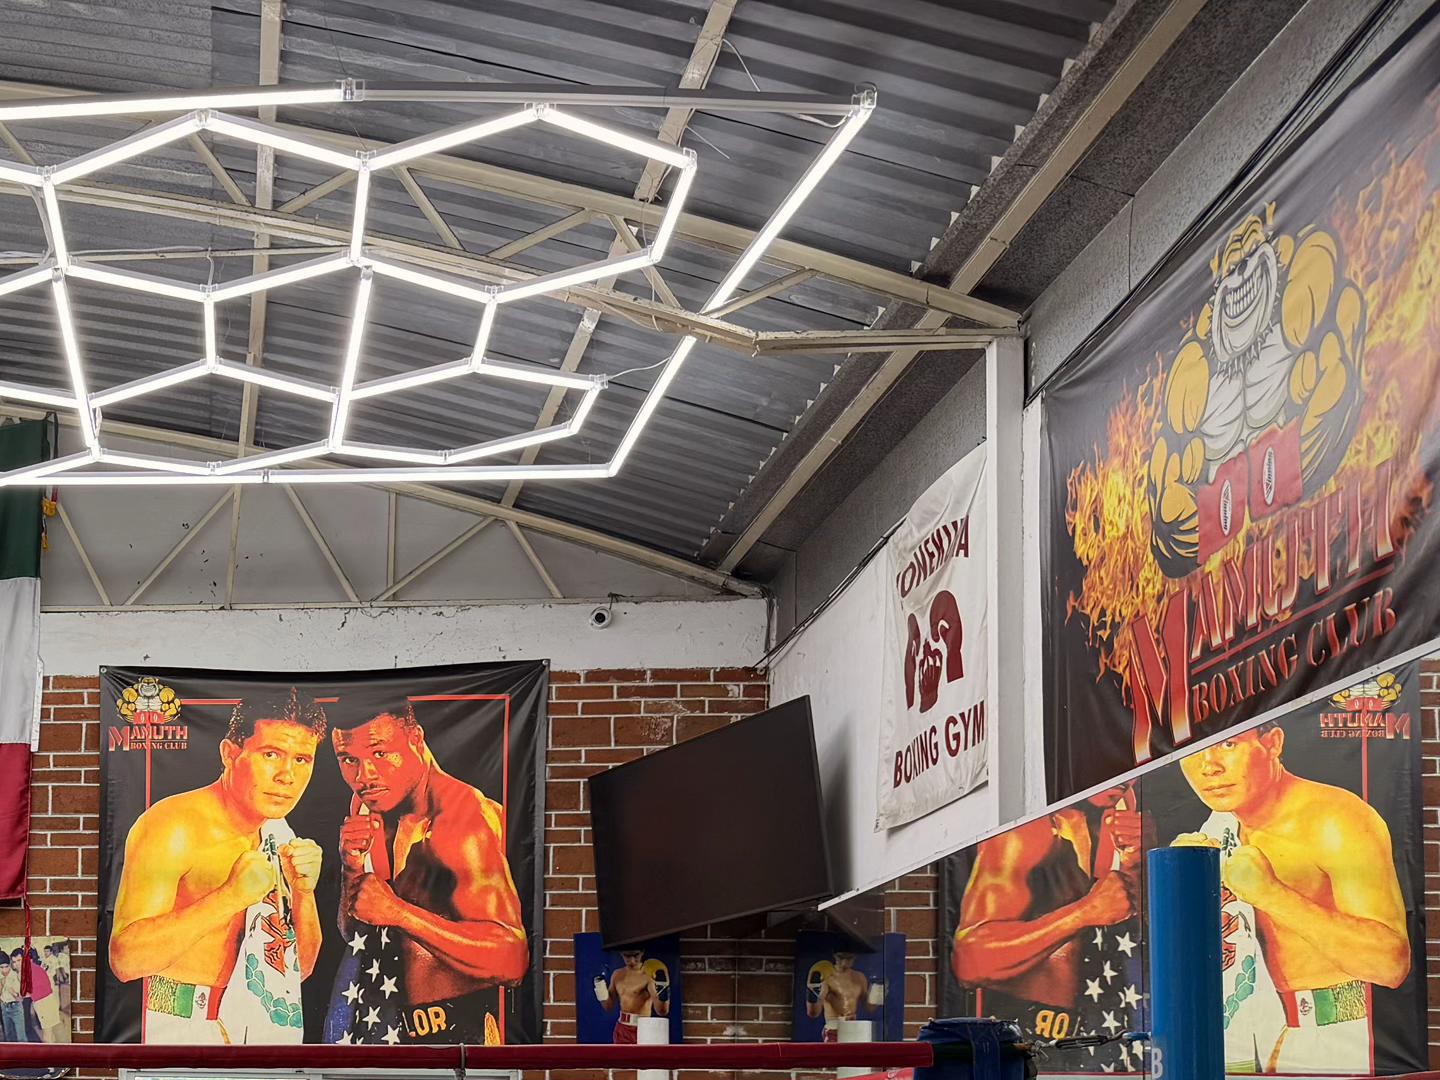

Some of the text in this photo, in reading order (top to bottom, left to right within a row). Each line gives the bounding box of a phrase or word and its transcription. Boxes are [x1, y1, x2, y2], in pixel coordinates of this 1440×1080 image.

[1191, 587, 1397, 724] BOXING CLUB
[108, 725, 188, 752] MAMUTH
[130, 742, 187, 750] BOXNG CLUB
[893, 700, 986, 788] BOXING GYM
